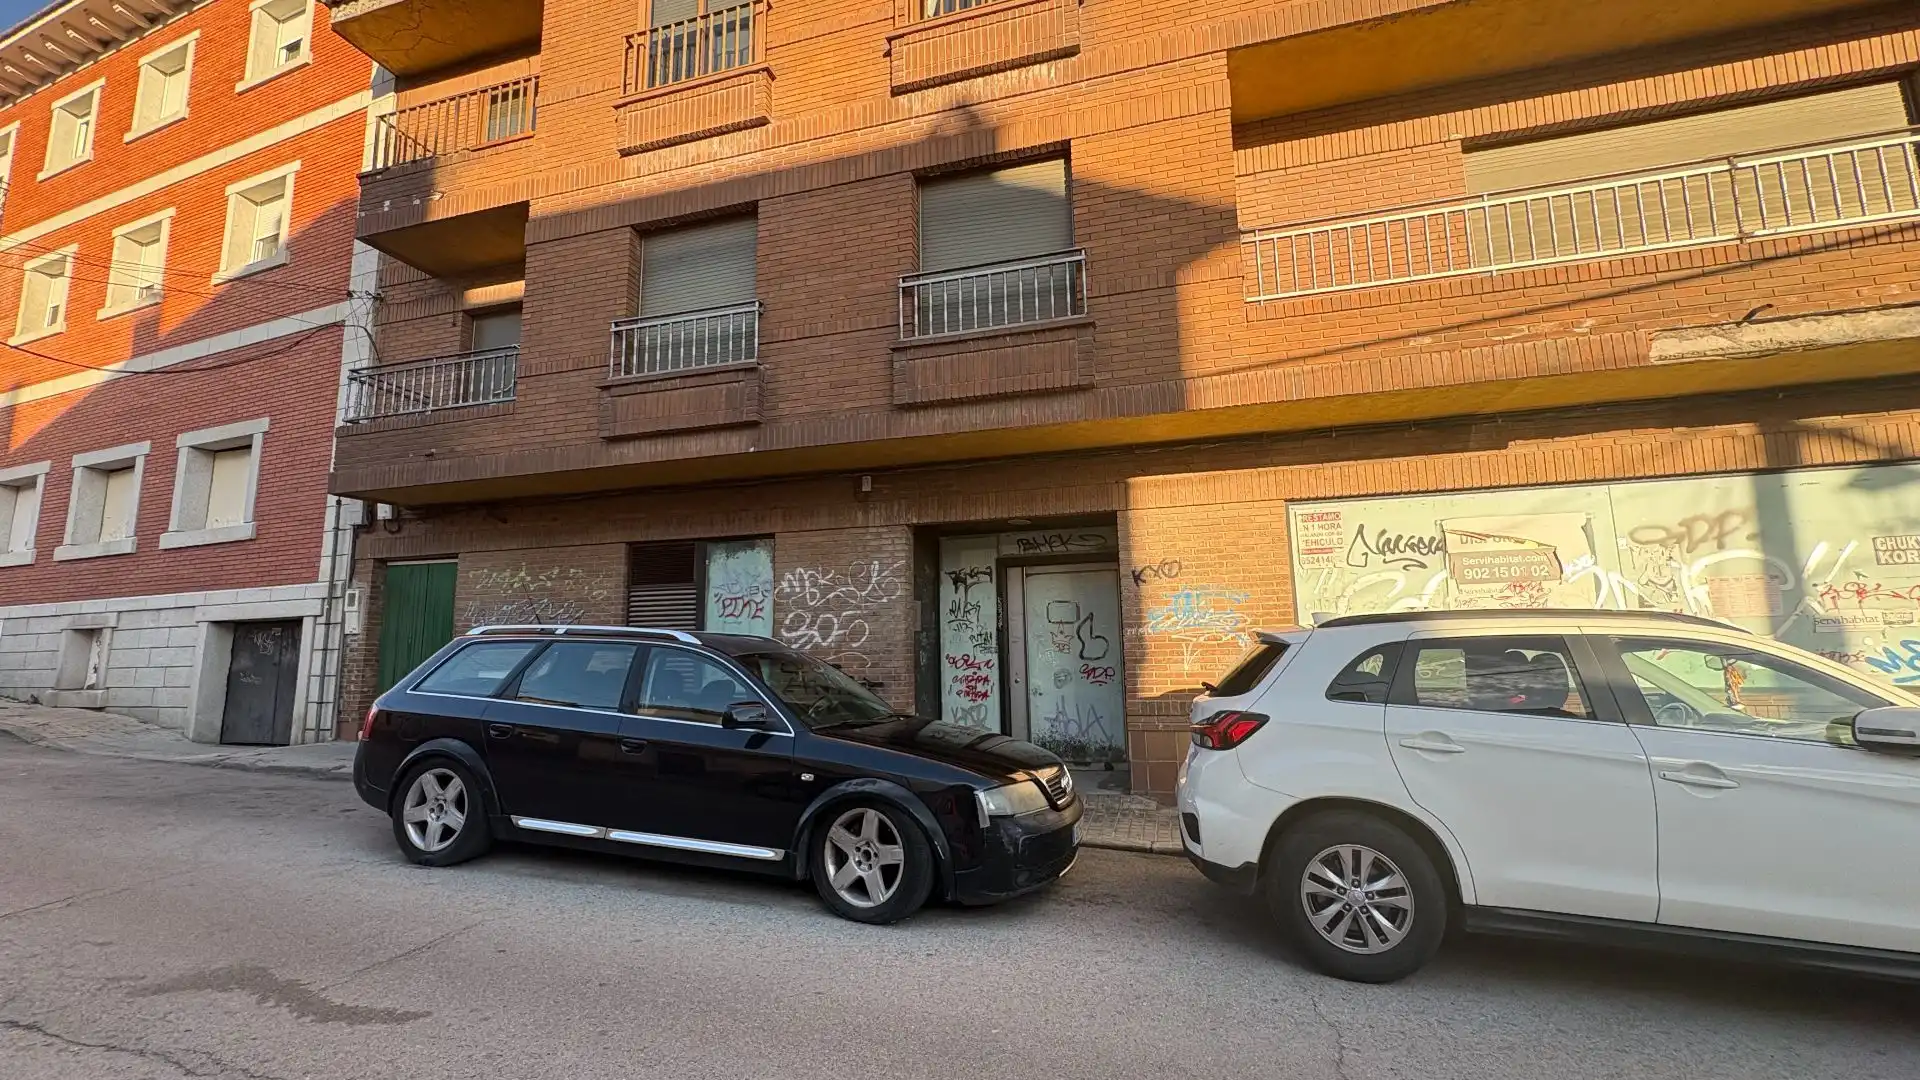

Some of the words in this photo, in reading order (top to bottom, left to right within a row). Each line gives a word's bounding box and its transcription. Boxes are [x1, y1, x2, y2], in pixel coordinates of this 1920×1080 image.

[1301, 512, 1341, 522] RESTAMO
[1318, 522, 1342, 531] HORA
[1462, 553, 1547, 566] Servihabitat.com
[1463, 567, 1490, 580] 902
[1492, 566, 1509, 578] 15
[1530, 564, 1549, 577] 02
